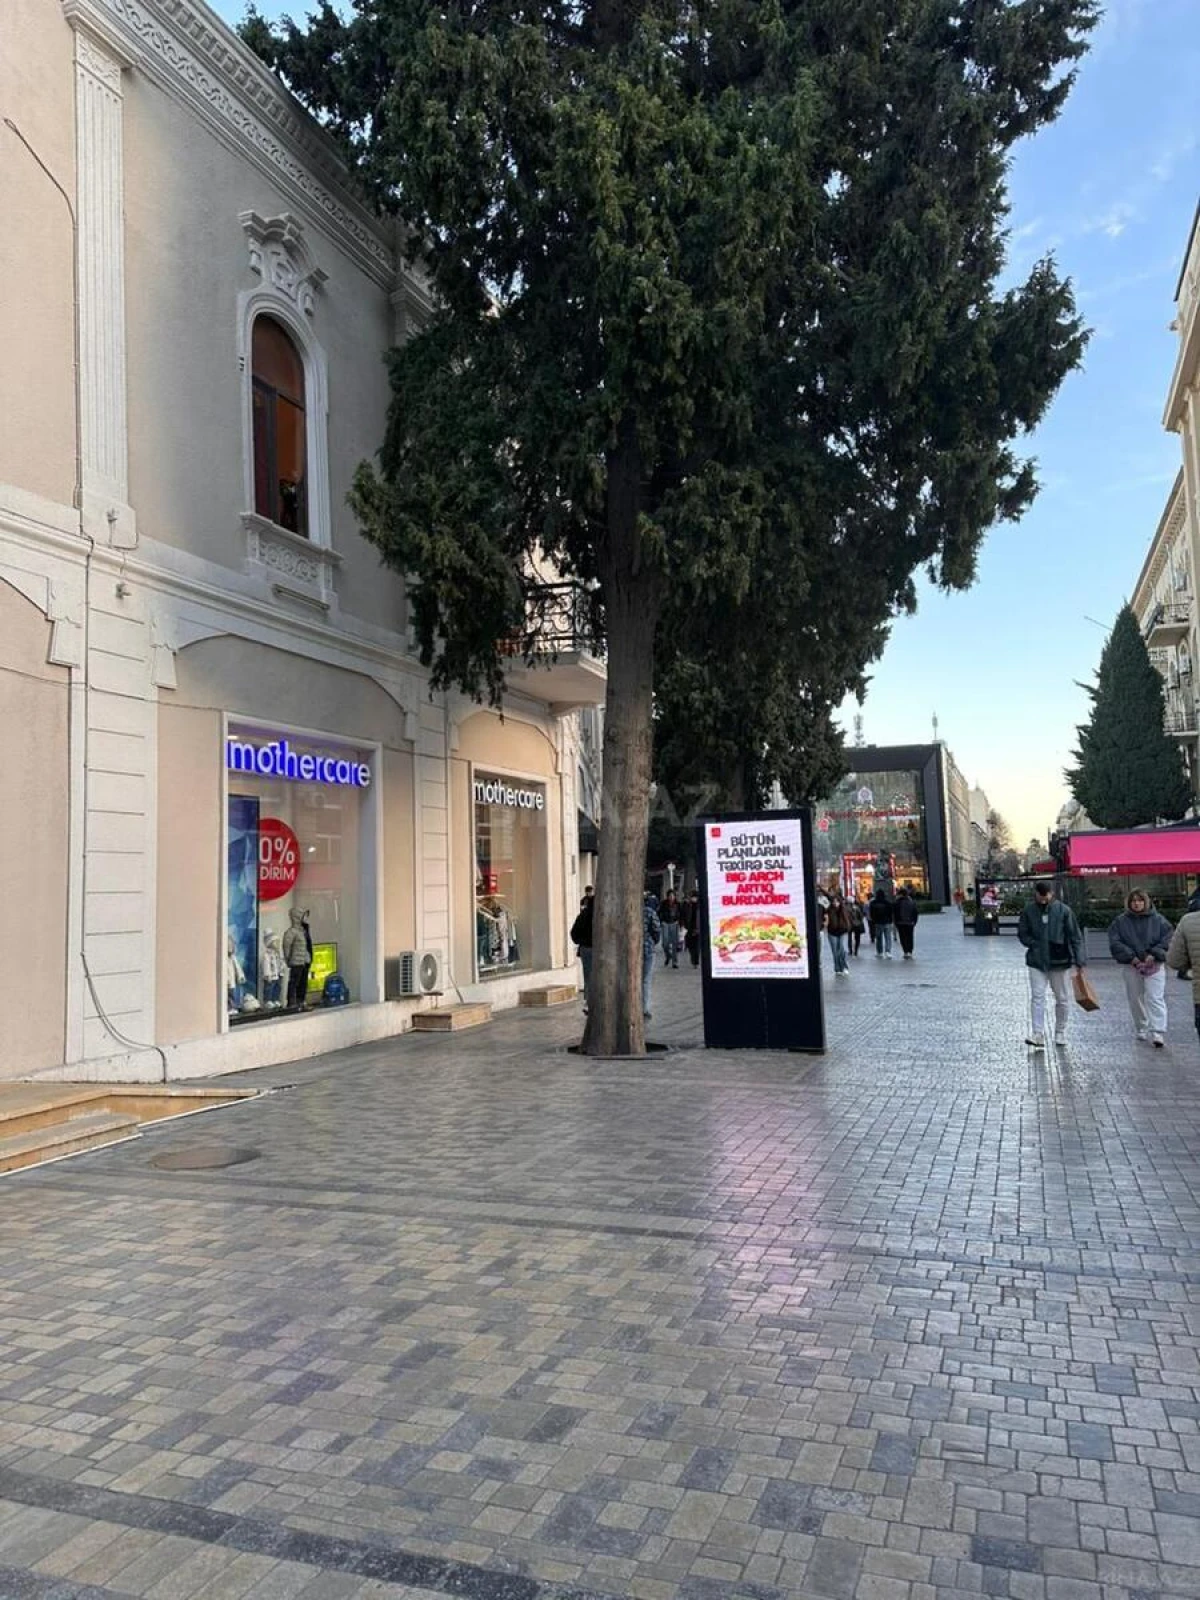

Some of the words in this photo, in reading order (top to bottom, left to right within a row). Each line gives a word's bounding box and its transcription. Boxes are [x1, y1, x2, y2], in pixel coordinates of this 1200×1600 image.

[230, 740, 371, 787] mothercare
[474, 778, 544, 810] mothercare
[730, 832, 776, 847] BÜTÜN
[717, 845, 790, 858] PLANLARINI
[764, 859, 792, 871] SAL.
[749, 871, 785, 882] ARCH
[736, 883, 775, 895] ARTIQ
